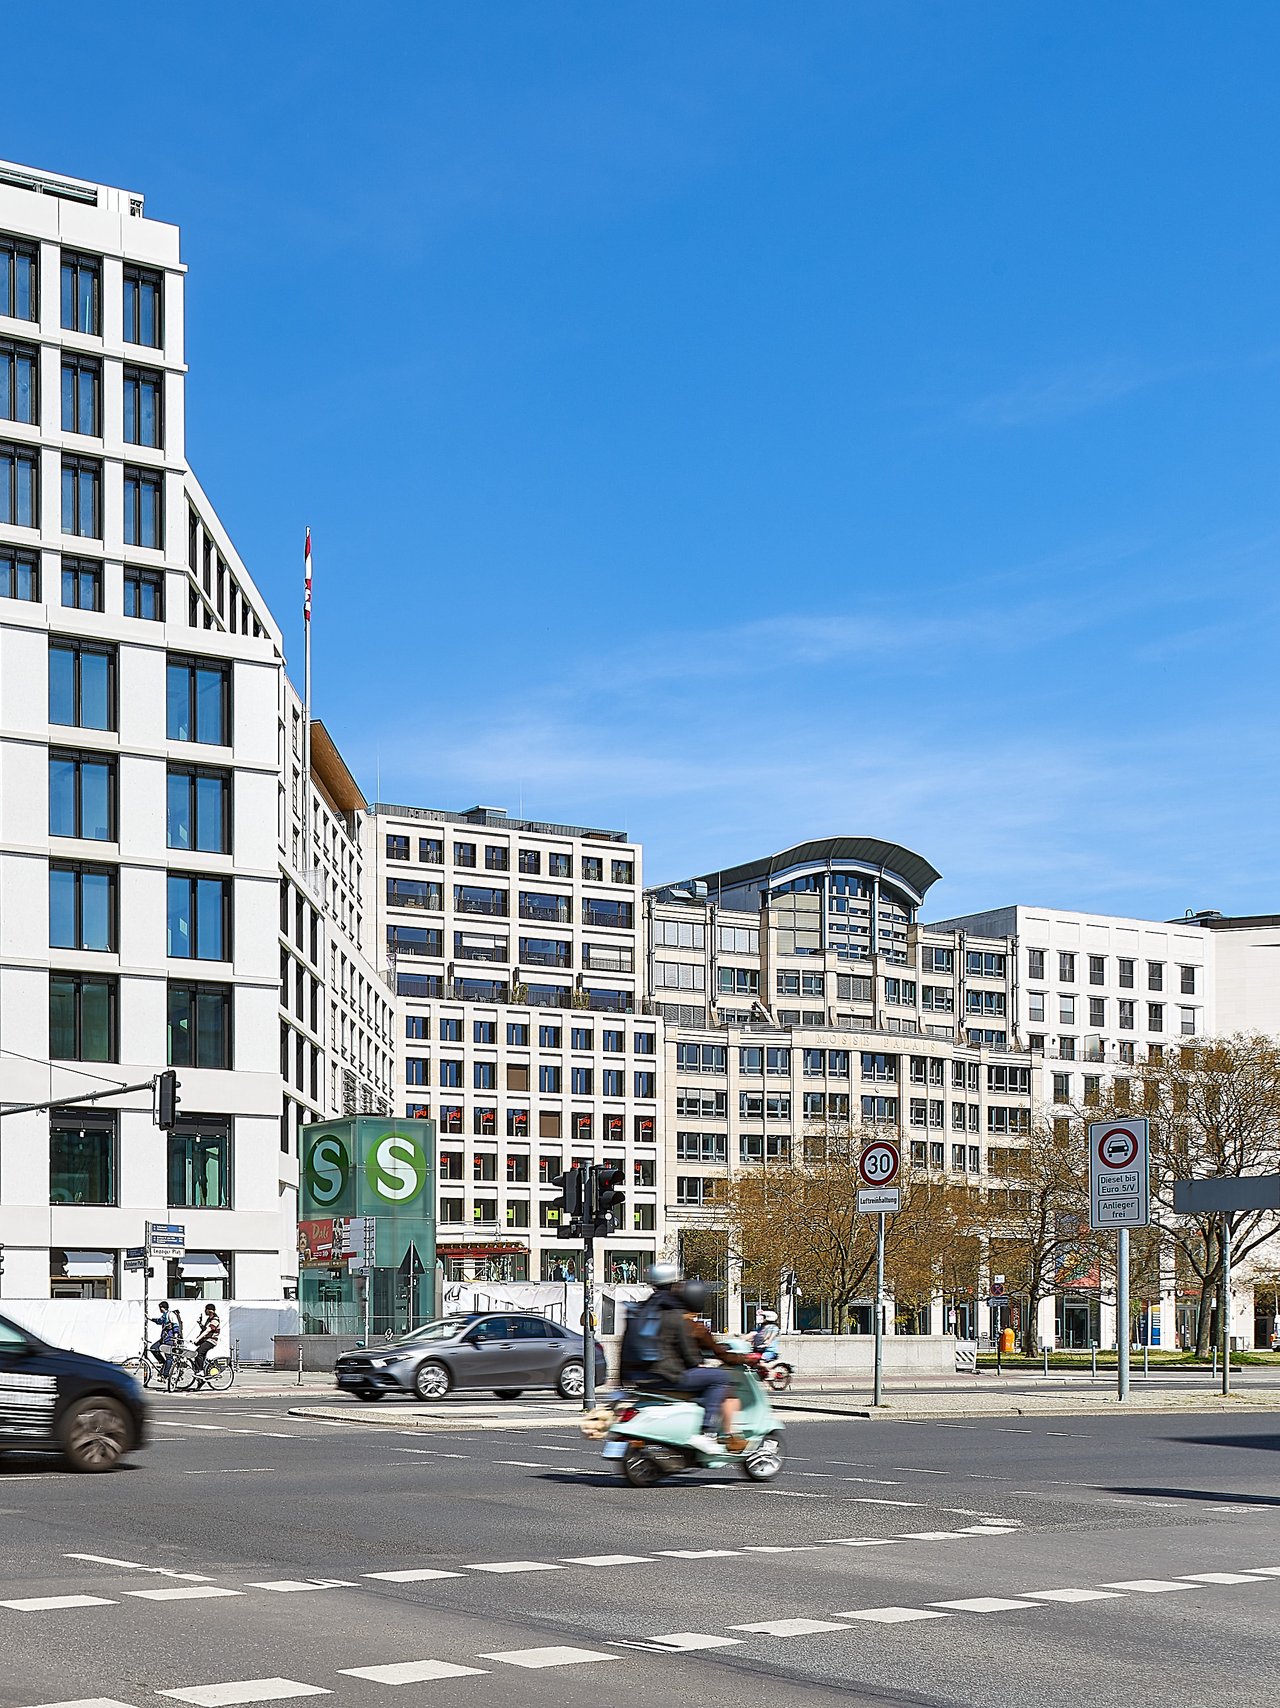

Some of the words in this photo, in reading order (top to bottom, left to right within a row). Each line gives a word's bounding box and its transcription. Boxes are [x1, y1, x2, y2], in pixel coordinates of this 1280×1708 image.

[816, 1033, 870, 1046] MOSSE
[883, 1037, 937, 1052] PALAIS
[313, 1140, 343, 1202] S
[376, 1137, 418, 1200] S
[867, 1153, 891, 1175] 30
[1100, 1175, 1123, 1184] Diesel
[1125, 1174, 1137, 1182] bis
[1121, 1184, 1136, 1192] 5/V
[1102, 1201, 1135, 1211] Anlieger
[1112, 1211, 1126, 1219] frei
